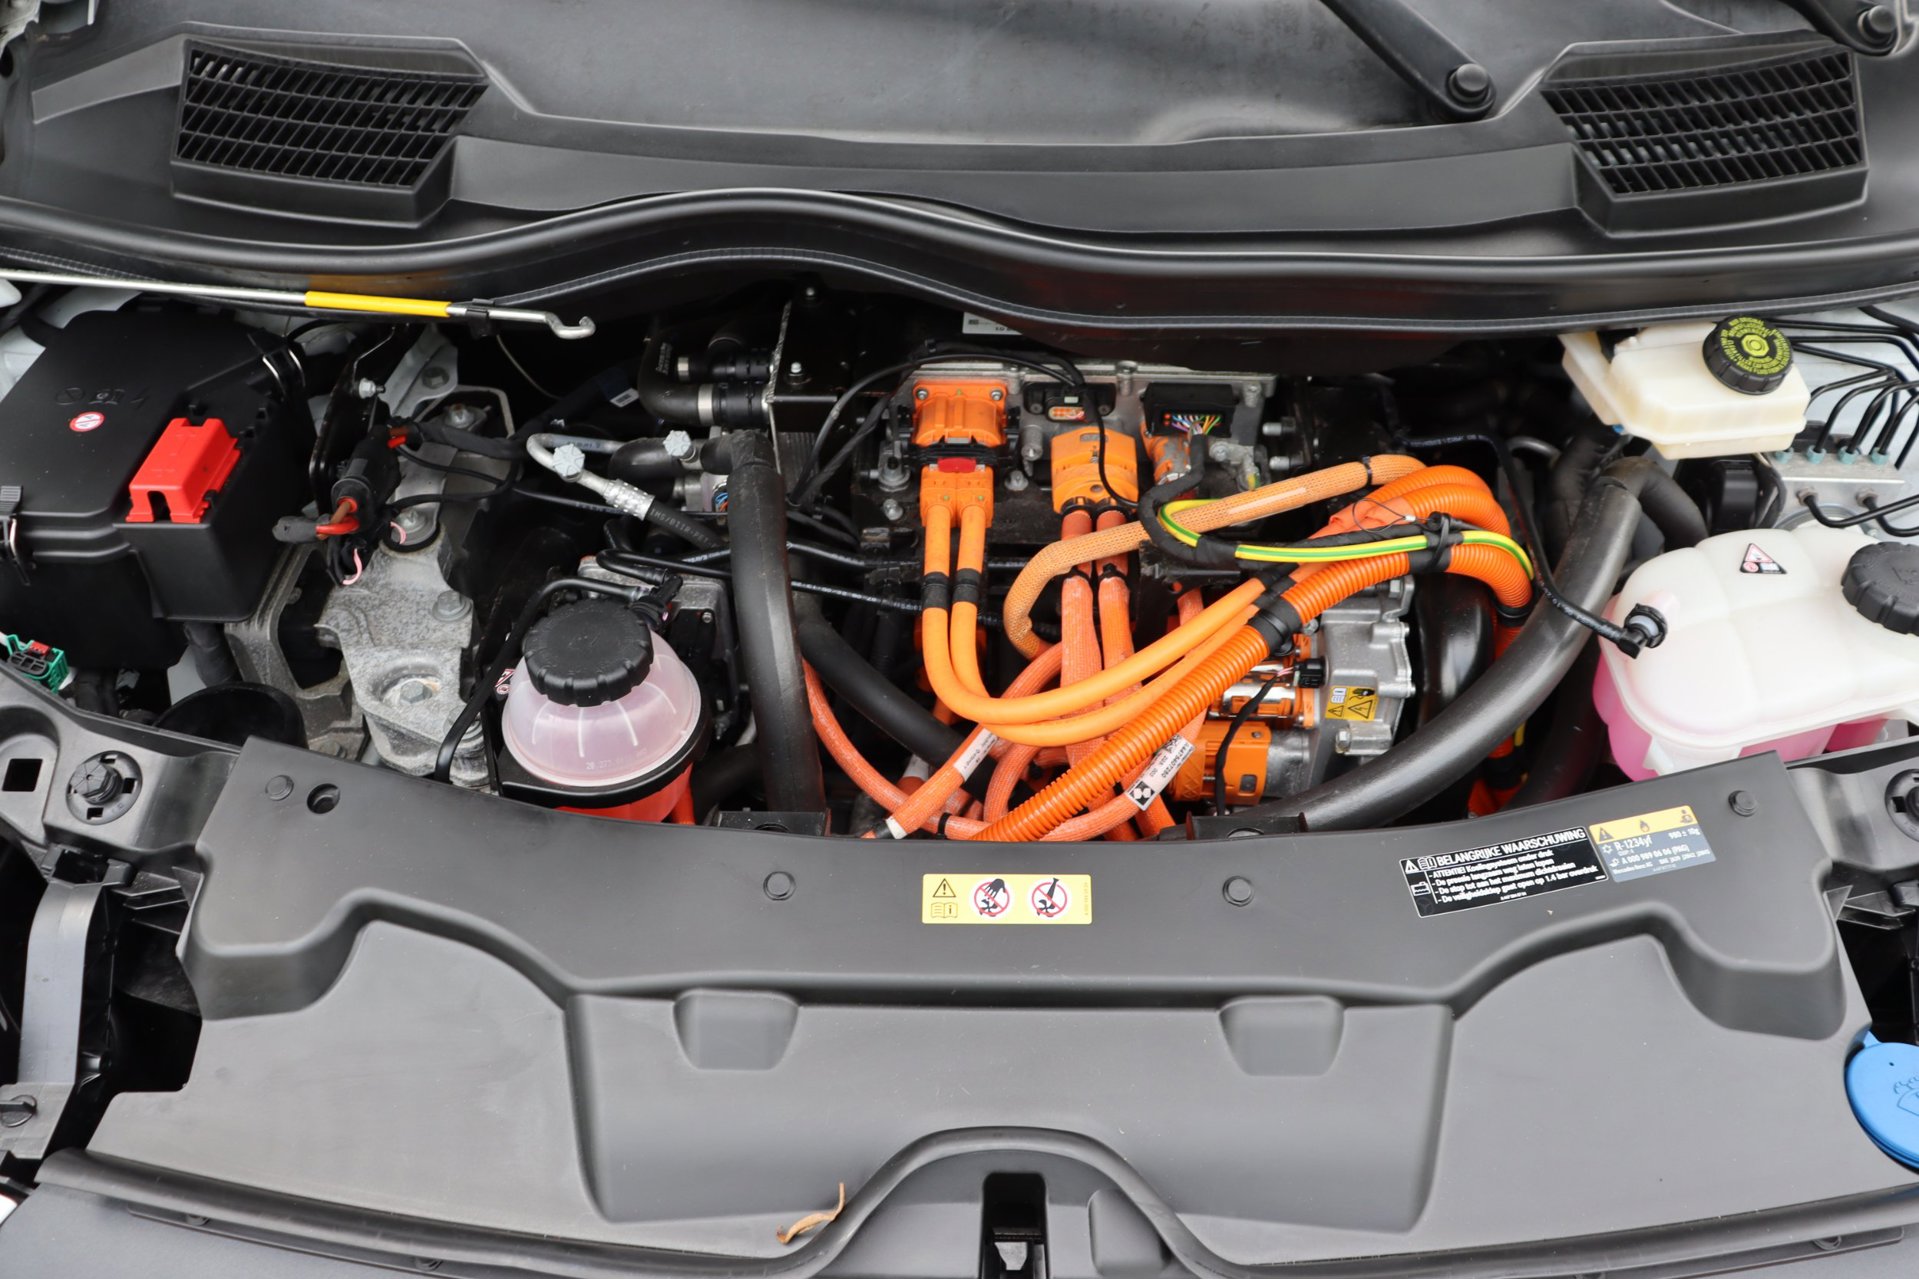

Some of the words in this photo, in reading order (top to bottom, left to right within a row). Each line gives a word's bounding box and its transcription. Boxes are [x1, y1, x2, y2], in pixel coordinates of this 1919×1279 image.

[1436, 846, 1502, 866] BELANGRIJKE
[1500, 829, 1587, 854] WAARSCHUWING
[1538, 849, 1554, 858] druk
[1614, 835, 1652, 854] R-1234yf
[1450, 885, 1465, 893] stop
[1465, 882, 1476, 890] tot
[1489, 877, 1502, 885] het
[1517, 880, 1535, 889] open
[1545, 874, 1557, 882] 1.4
[1569, 865, 1598, 877] overdruk
